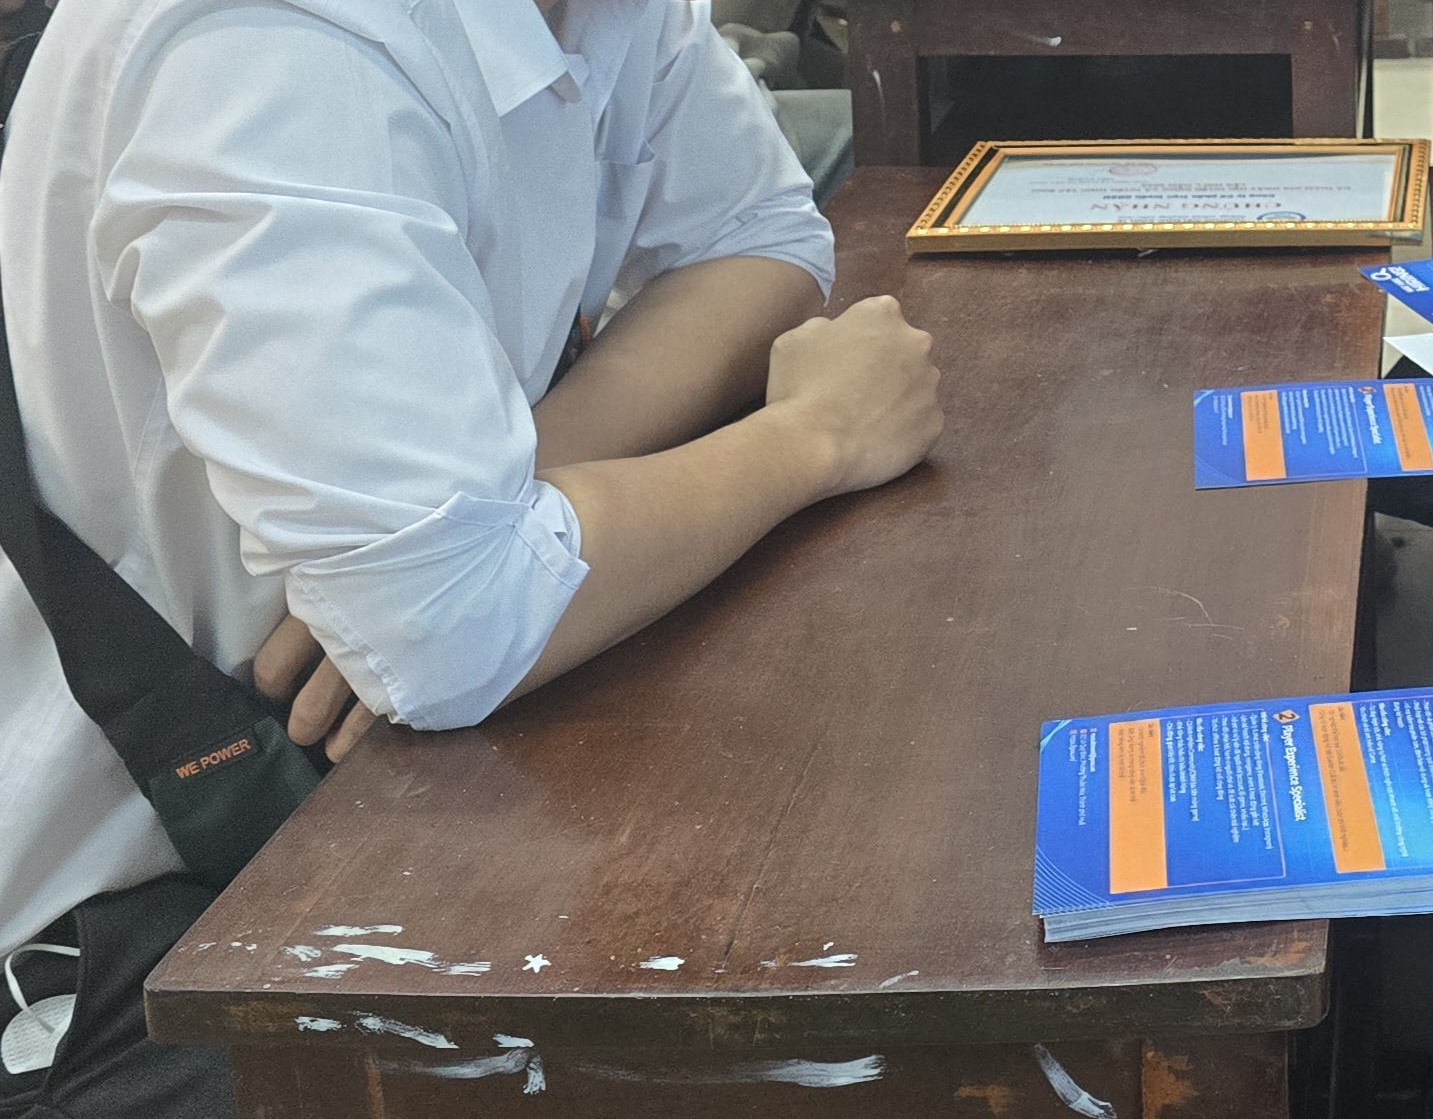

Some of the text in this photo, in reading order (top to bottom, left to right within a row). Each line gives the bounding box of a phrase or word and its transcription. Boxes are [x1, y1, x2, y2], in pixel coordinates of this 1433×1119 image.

[175, 738, 252, 779] WE POWER
[1283, 746, 1301, 786] Experience
